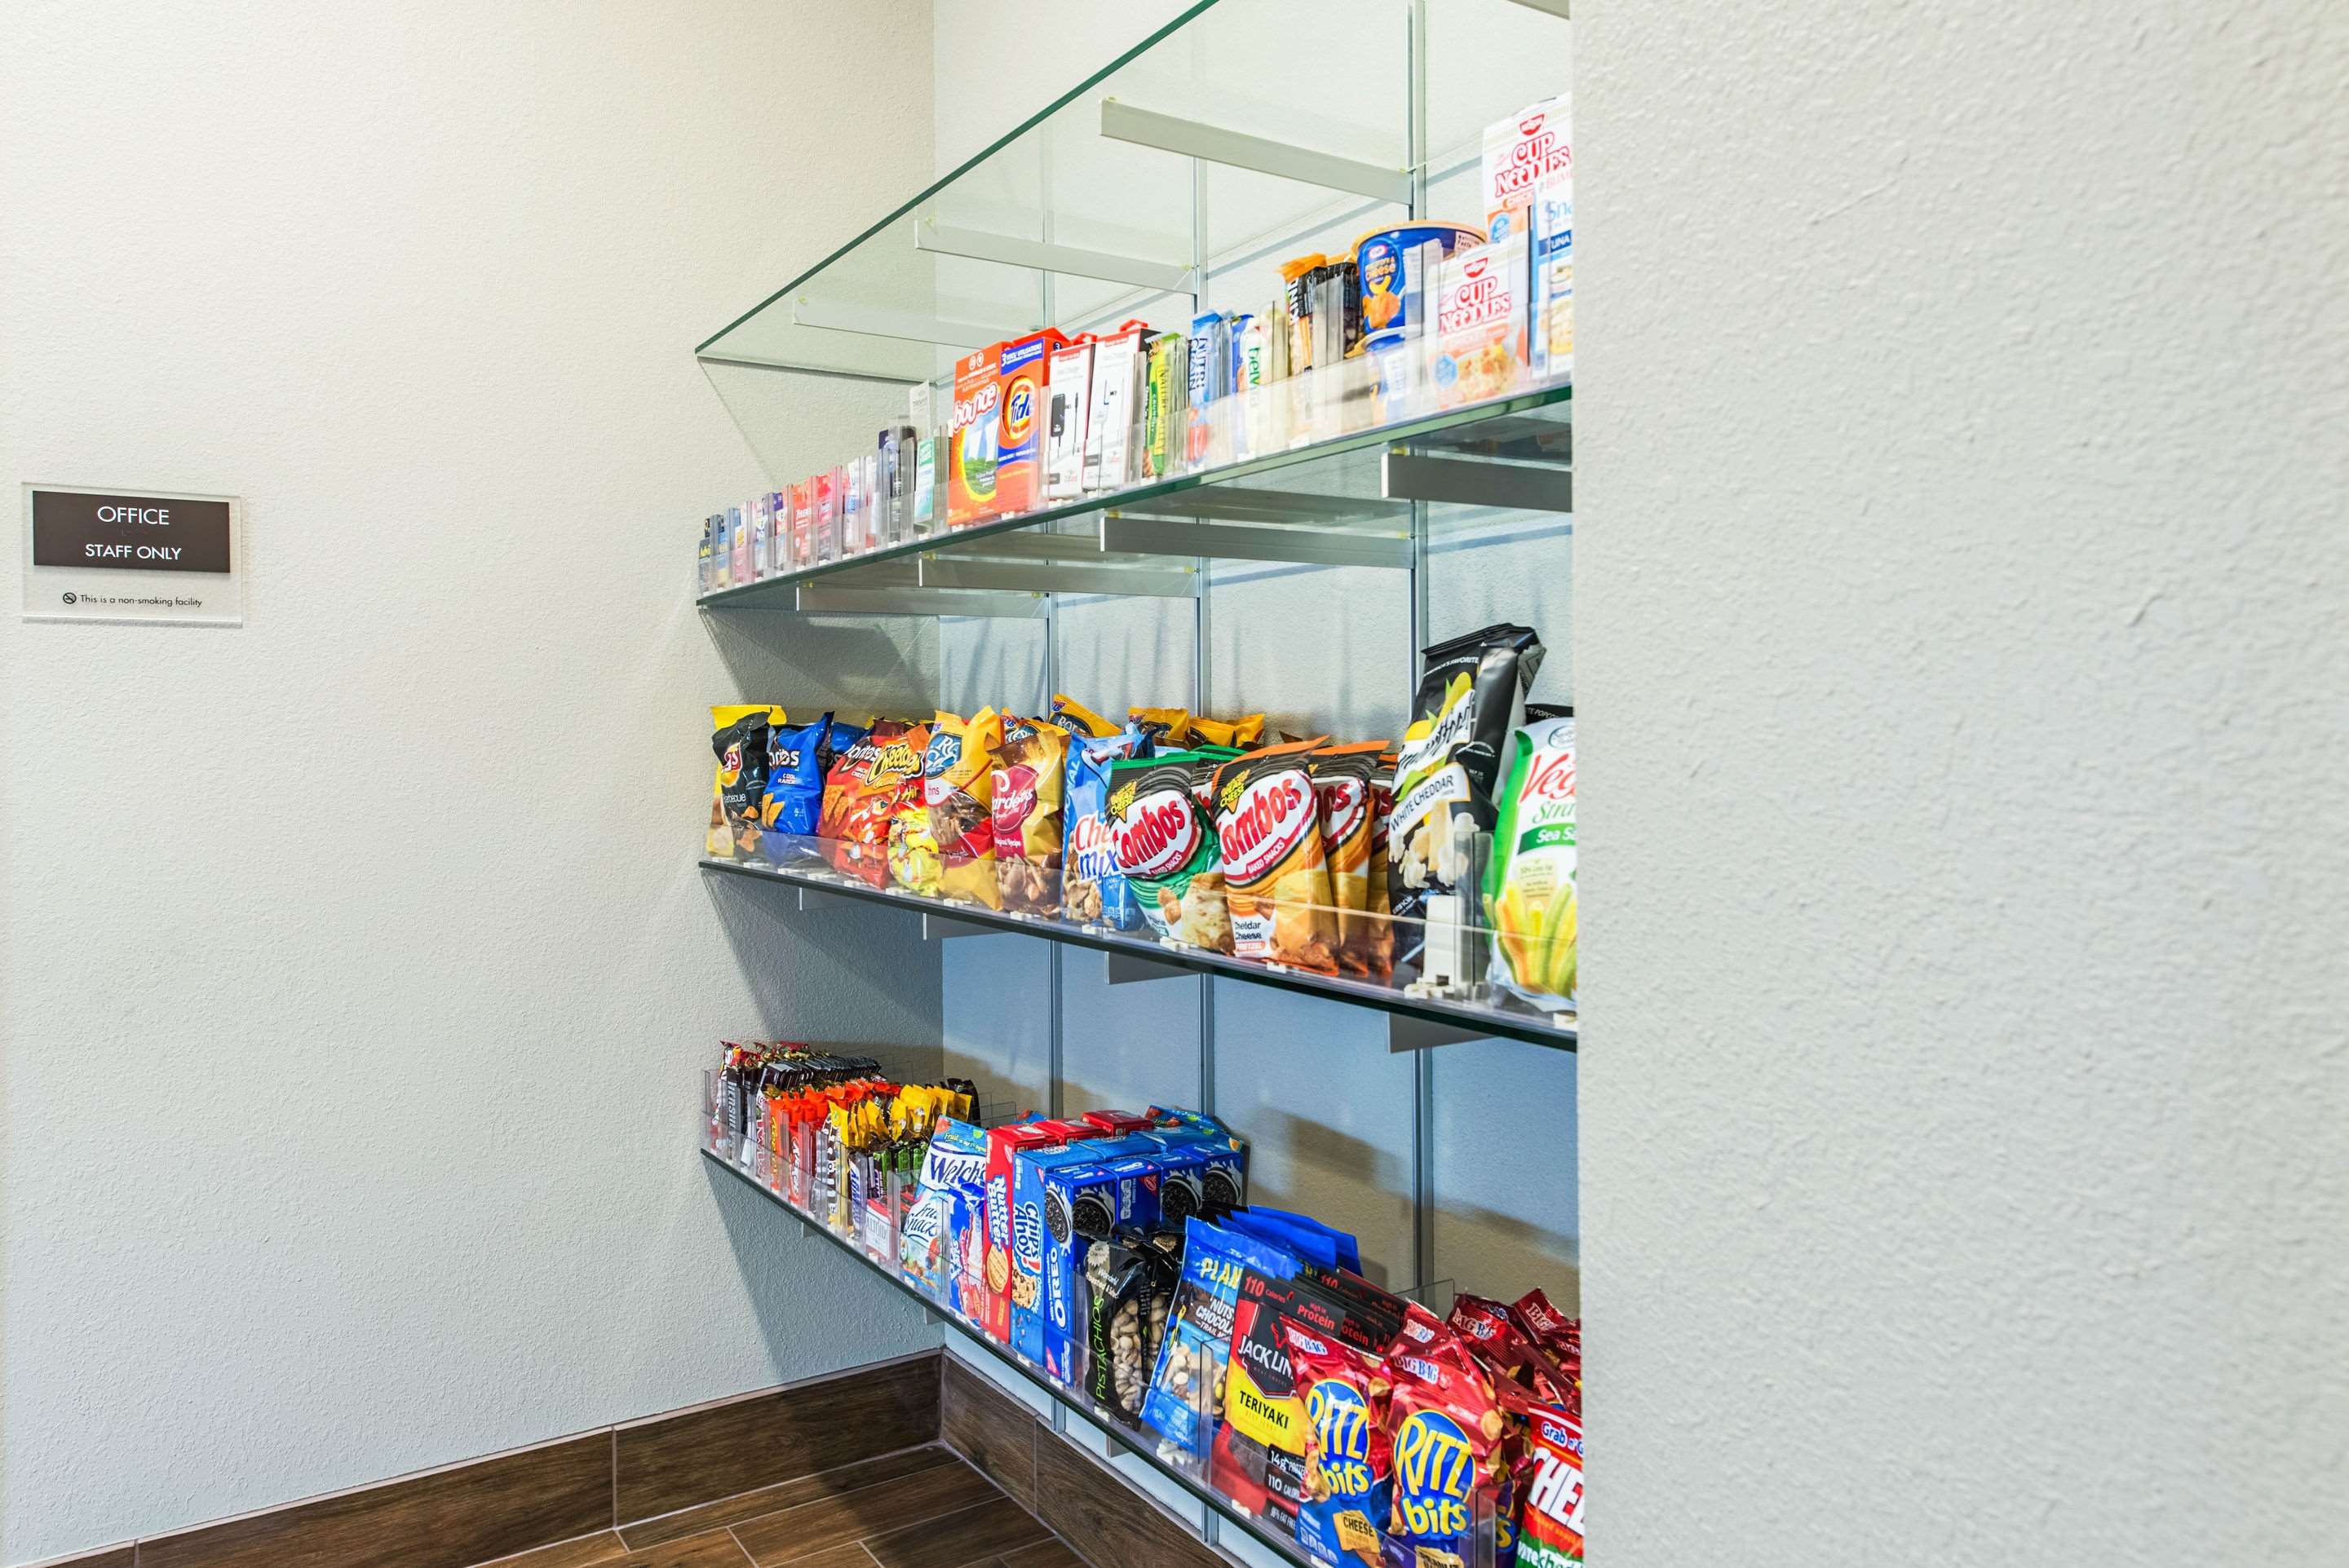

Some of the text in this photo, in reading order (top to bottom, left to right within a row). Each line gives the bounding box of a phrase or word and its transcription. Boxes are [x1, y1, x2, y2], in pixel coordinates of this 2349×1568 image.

[1512, 132, 1554, 166] CUP
[1495, 146, 1572, 198] NOODLES
[1455, 276, 1497, 309] CUP
[1439, 292, 1512, 336] NOODLES
[953, 382, 999, 434] bounce
[97, 506, 170, 525] OFFICE
[85, 543, 182, 560] STAFF ONLY
[80, 594, 97, 604] This
[100, 595, 108, 604] is
[118, 596, 173, 607] non-smoking
[175, 596, 202, 607] facility
[866, 742, 922, 784] Cheetos
[1519, 753, 1576, 804] Veg
[1391, 775, 1454, 832] WHITE CHEDDAR
[1533, 802, 1576, 824] Stra
[1075, 814, 1110, 851] Che
[1537, 828, 1560, 843] Sea
[1080, 850, 1120, 880] mix
[1247, 840, 1285, 875] BAKED SNACKS
[905, 1212, 937, 1237] Snack
[987, 1182, 1003, 1253] Butter
[994, 1176, 1009, 1245] Nutter
[1024, 1203, 1040, 1262] Chips
[1051, 1247, 1066, 1328] OREO
[1201, 1257, 1244, 1289] PLAN
[1244, 1274, 1265, 1297] 110
[1196, 1305, 1233, 1335] CHOCOLA
[1298, 1304, 1335, 1331] Protein
[1095, 1295, 1104, 1400] PISTACHIOS
[1288, 1327, 1327, 1355] BIG BAG
[1341, 1324, 1369, 1346] otein
[1237, 1335, 1294, 1380] JACK LIN
[1417, 1361, 1439, 1384] BAG
[1240, 1390, 1290, 1429] TERIYAKI
[1542, 1424, 1566, 1444] Grab
[1288, 1461, 1306, 1479] PROTE
[1396, 1416, 1473, 1497] RITZ
[1267, 1473, 1282, 1491] 110
[1318, 1461, 1369, 1496] bits
[1343, 1516, 1374, 1538] CHEESE
[1403, 1497, 1467, 1535] bits
